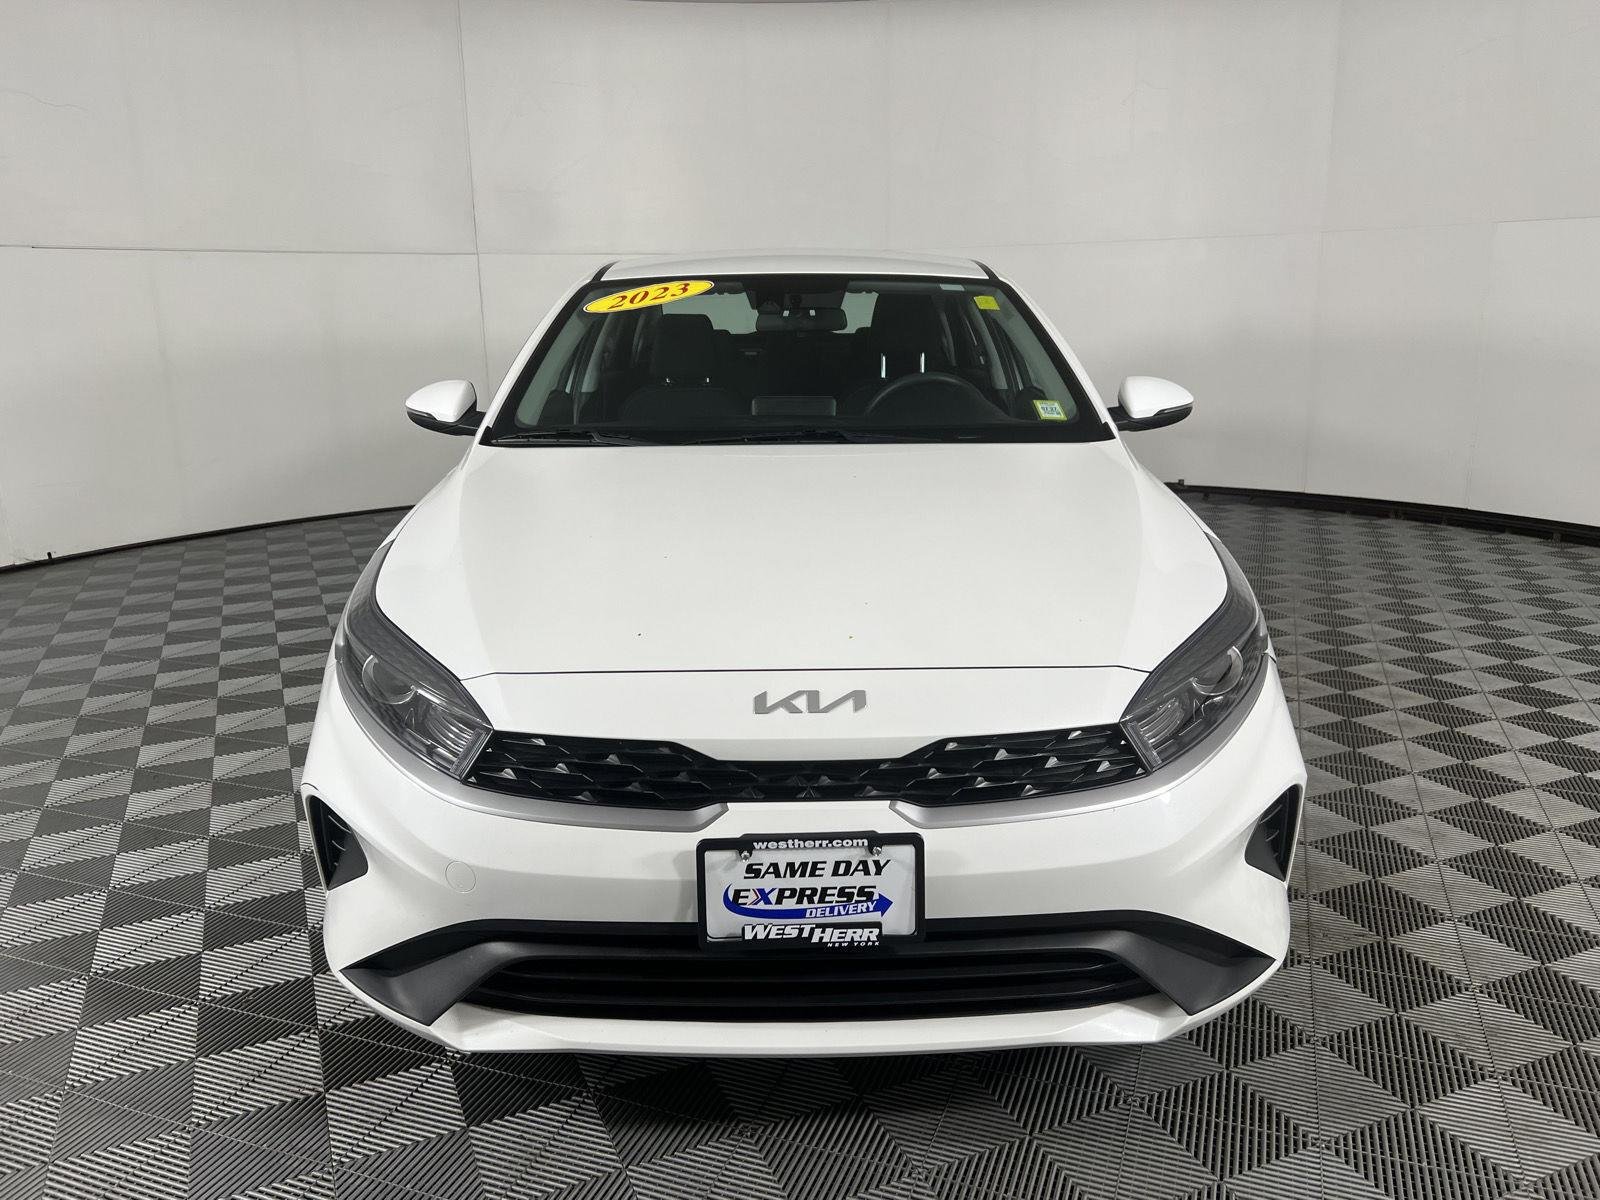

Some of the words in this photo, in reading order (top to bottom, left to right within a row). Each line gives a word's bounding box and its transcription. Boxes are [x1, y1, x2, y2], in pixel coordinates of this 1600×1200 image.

[607, 282, 690, 310] 2023
[753, 689, 867, 714] KIA
[752, 838, 868, 850] westherr.com
[743, 860, 826, 880] SAME
[830, 858, 892, 878] DAY
[730, 885, 877, 906] EXPRESS
[805, 900, 878, 918] DELIVERY
